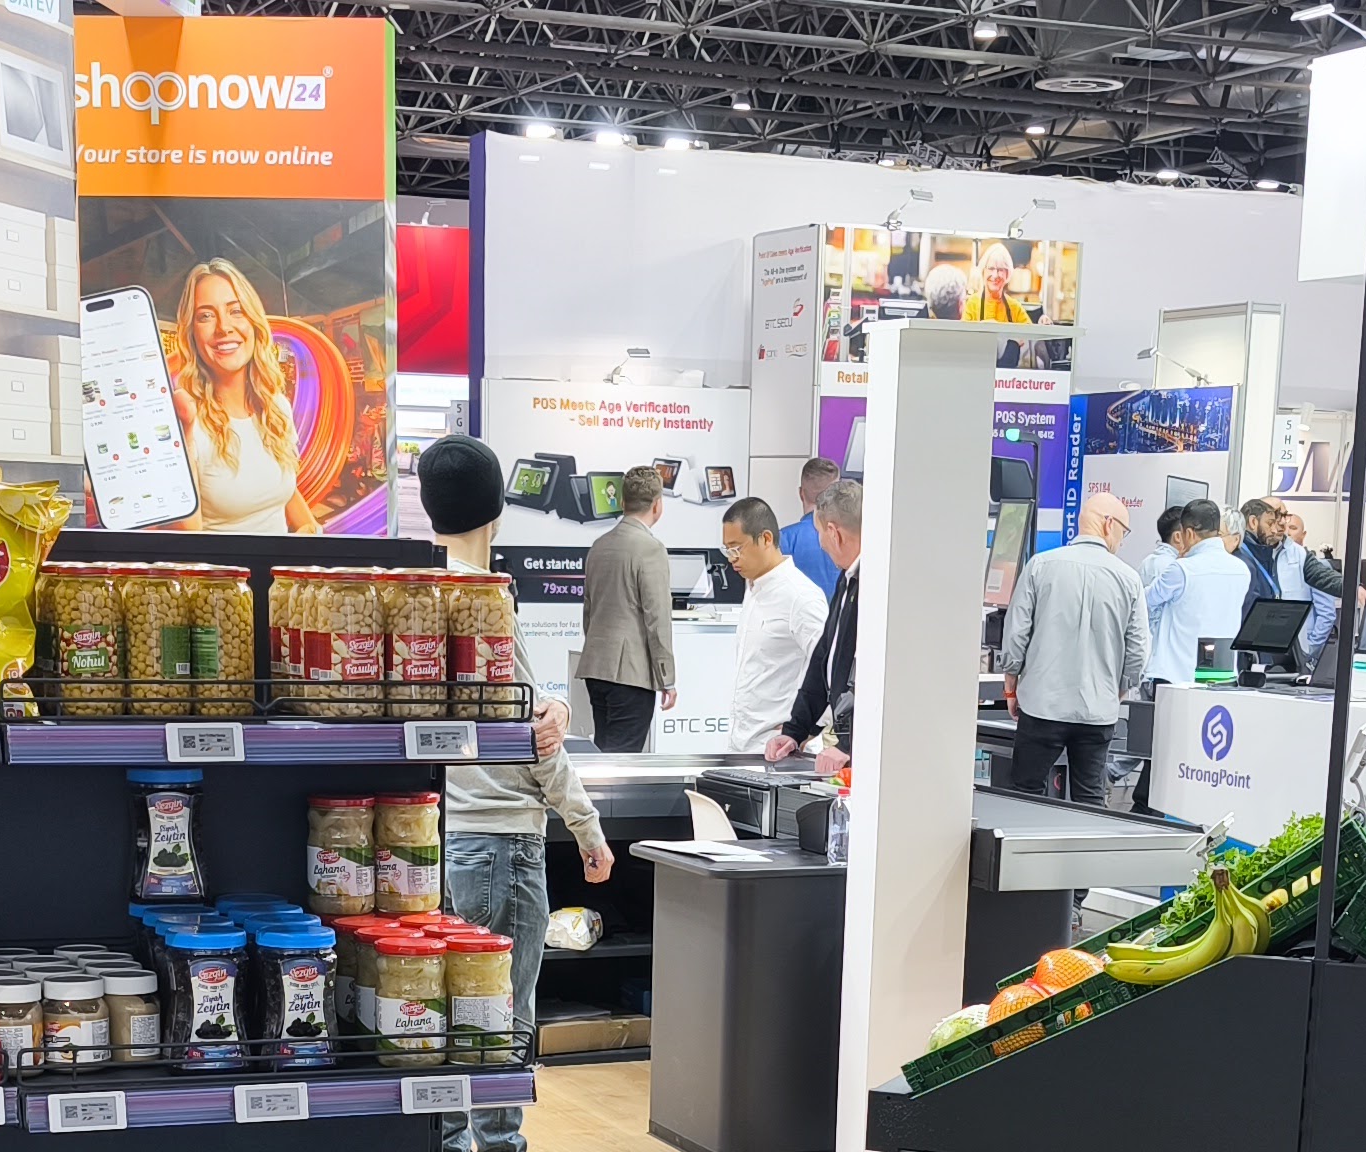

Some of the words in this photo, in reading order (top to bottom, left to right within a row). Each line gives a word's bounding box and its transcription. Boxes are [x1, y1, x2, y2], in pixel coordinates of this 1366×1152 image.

[125, 146, 183, 164] store
[188, 146, 207, 164] is
[212, 147, 258, 165] now
[265, 146, 333, 166] online
[456, 403, 462, 413] 5
[532, 397, 556, 410] POS
[560, 398, 596, 411] Meets
[598, 400, 621, 414] Age
[625, 401, 690, 414] Verification
[456, 417, 463, 427] G
[578, 415, 599, 427] Sell
[602, 416, 624, 427] and
[627, 416, 660, 430] Verify
[663, 417, 714, 432] Instantly
[995, 410, 1016, 424] POS
[1018, 412, 1056, 427] System
[1286, 420, 1292, 430] 5
[1068, 413, 1082, 481] Reader
[1284, 435, 1292, 445] H
[1281, 450, 1292, 460] 25
[1067, 487, 1077, 507] ID
[524, 558, 543, 571] Get
[546, 557, 583, 570] started
[543, 582, 568, 595] 79xx
[663, 718, 701, 734] BTC
[705, 717, 729, 733] SE
[1178, 763, 1251, 791] StrongPoint
